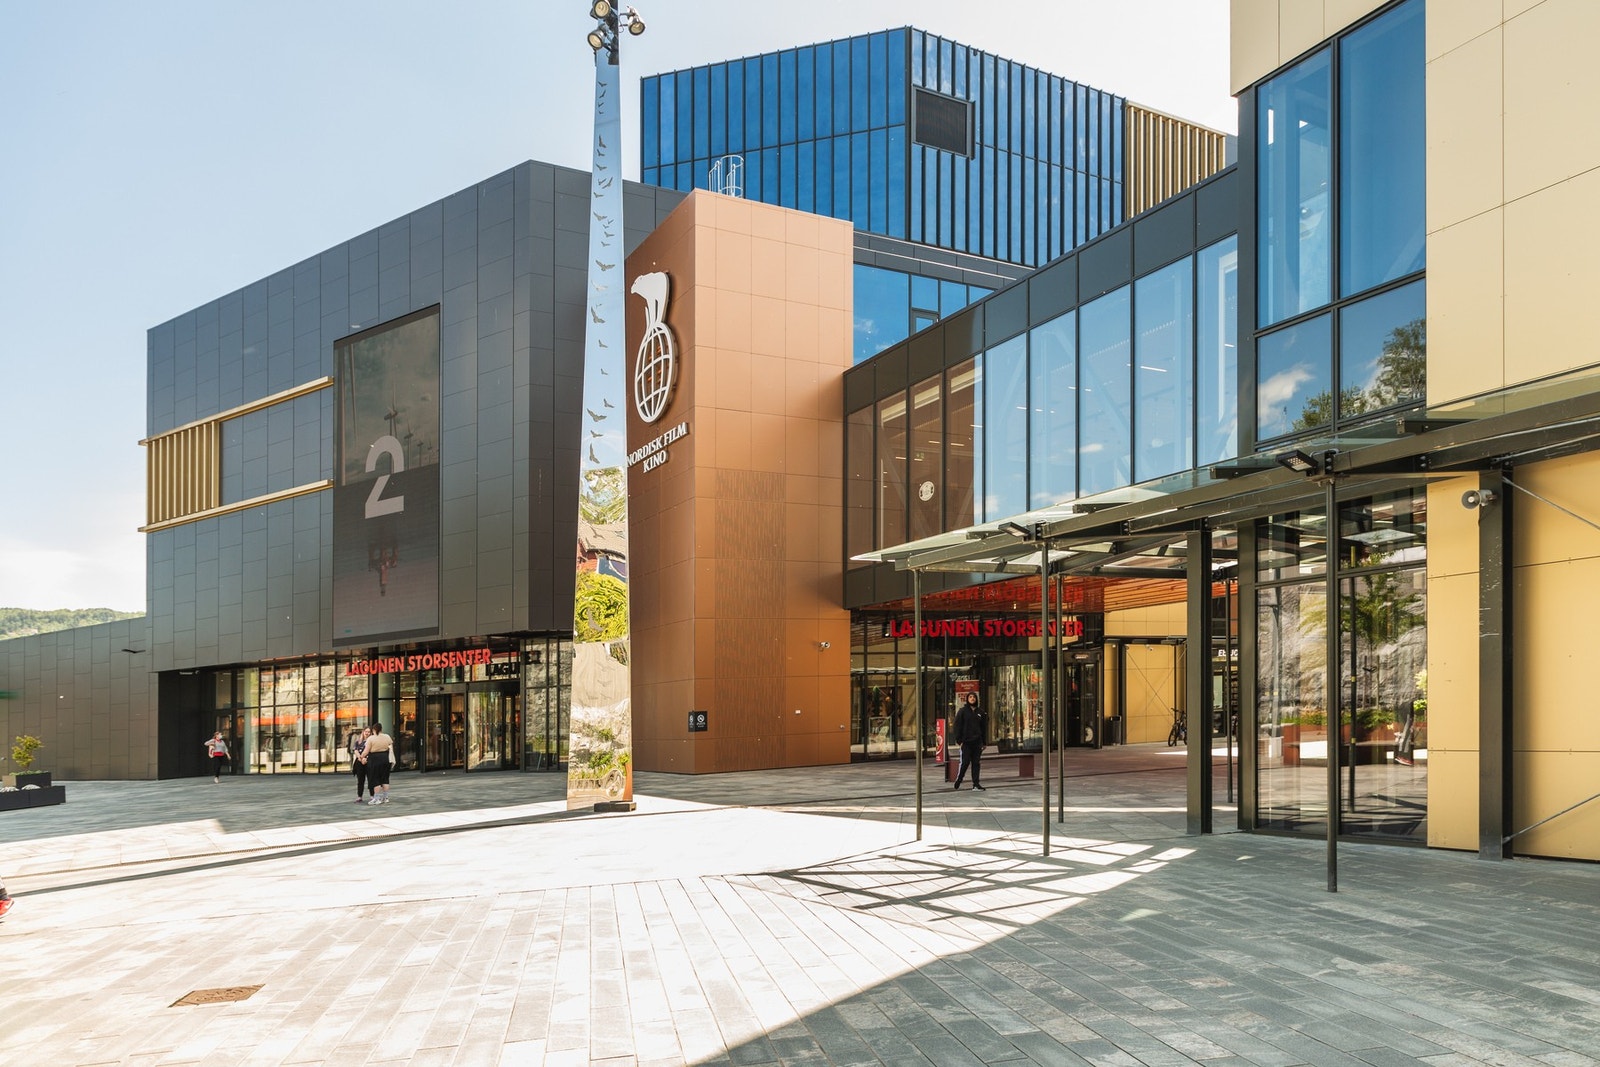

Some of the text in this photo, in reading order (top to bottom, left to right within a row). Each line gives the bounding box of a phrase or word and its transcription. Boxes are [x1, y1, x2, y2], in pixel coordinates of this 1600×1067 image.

[626, 421, 688, 468] NORDISK FILM
[643, 450, 667, 473] KINO
[365, 435, 404, 519] 2
[890, 619, 980, 637] LAGUNEN
[346, 648, 492, 676] LAGUNEN STORSENTER
